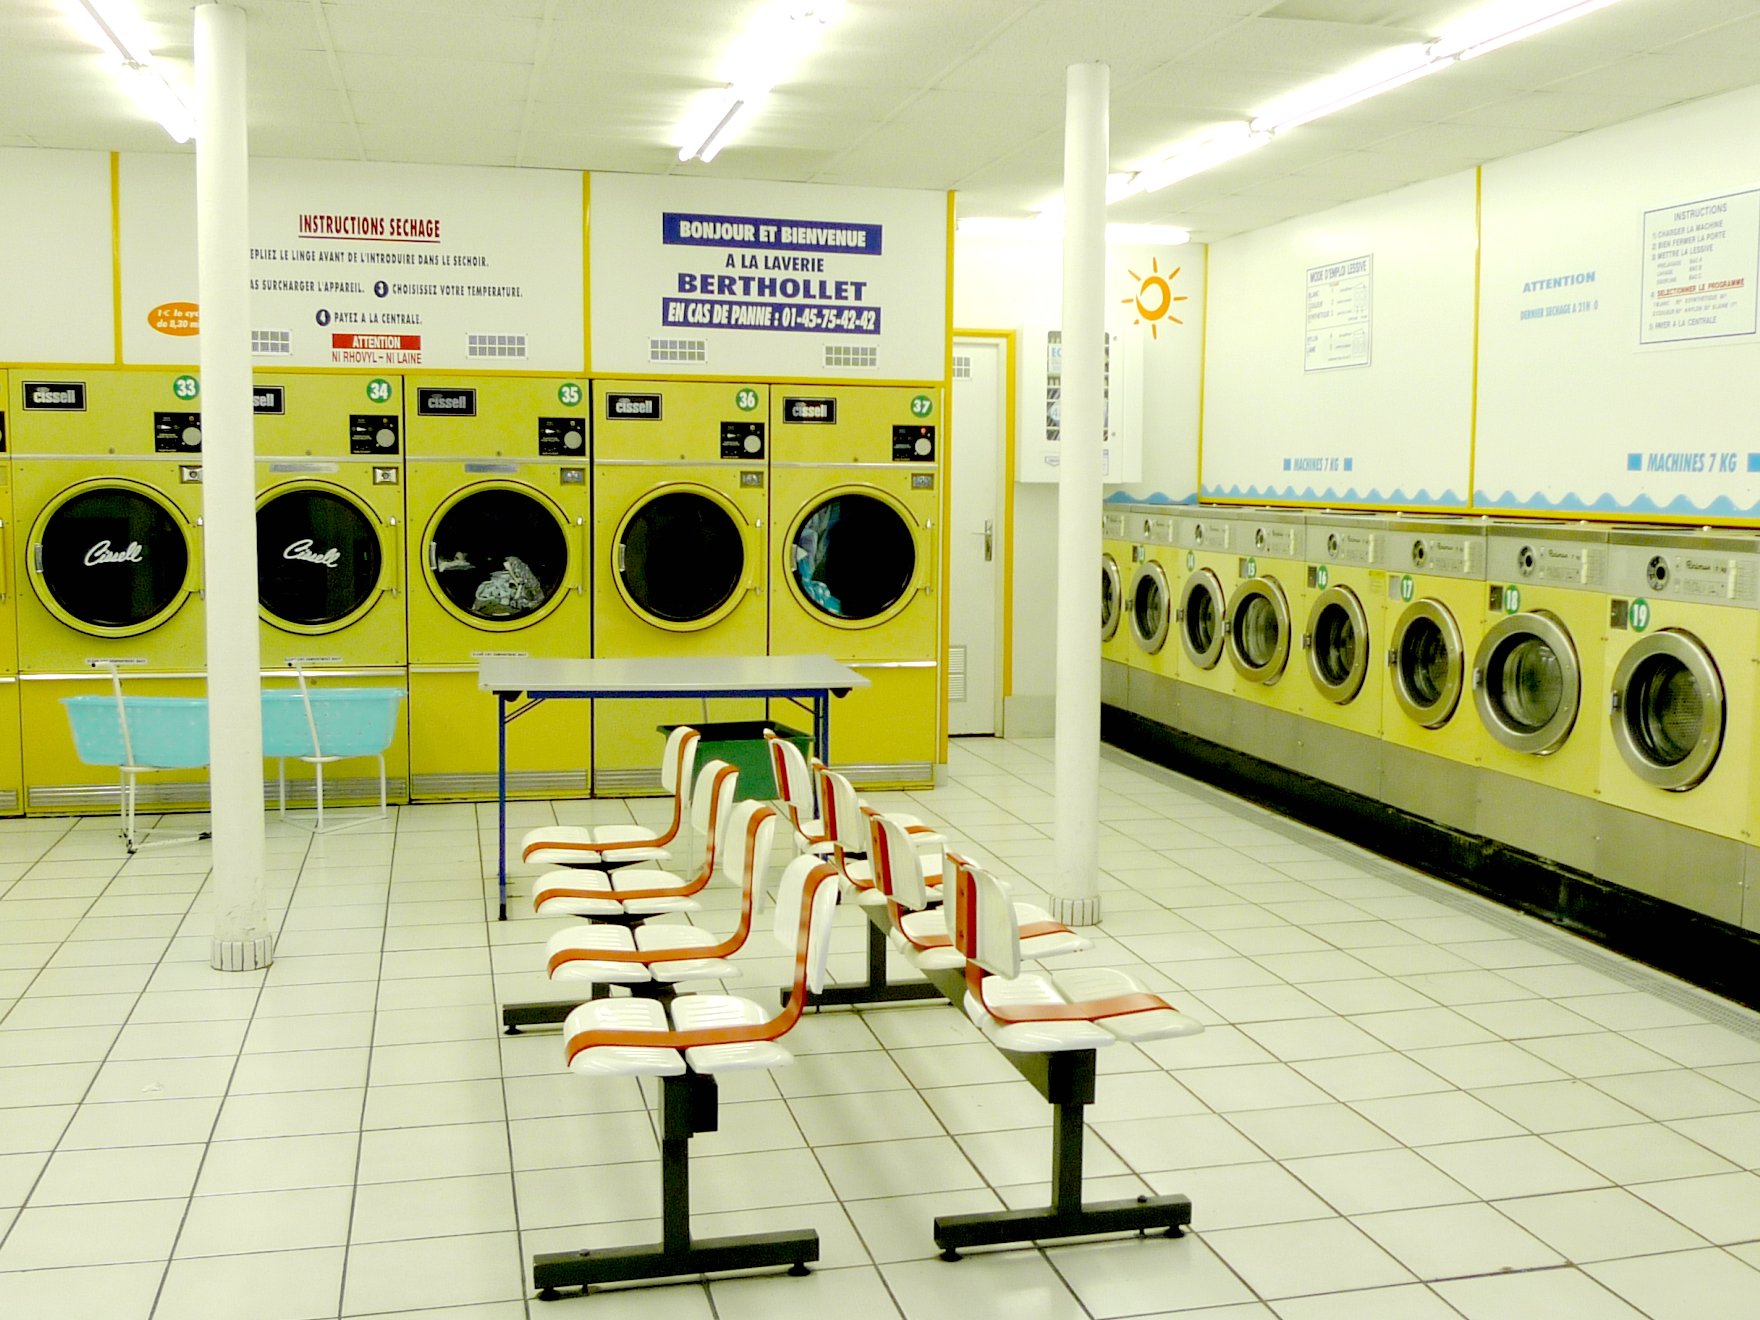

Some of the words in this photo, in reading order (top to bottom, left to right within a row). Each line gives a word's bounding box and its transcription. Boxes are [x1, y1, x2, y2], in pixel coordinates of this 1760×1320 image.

[1674, 203, 1728, 221] INSTRUCTIONS
[299, 214, 385, 236] INSTRUCTIONS
[389, 218, 440, 238] SECHAGE
[680, 221, 755, 241] BONJOUR
[759, 225, 777, 242] ET
[781, 227, 866, 247] BIENVENUE
[1658, 226, 1685, 238] CHARGER
[1686, 226, 1694, 234] LA
[1695, 219, 1723, 231] MACHINE
[1658, 241, 1671, 250] BIEN
[1672, 236, 1696, 247] FERMER
[1697, 234, 1705, 242] LA
[1706, 230, 1727, 240] PORTE
[280, 250, 288, 260] LE
[292, 250, 315, 261] LINGE
[319, 251, 344, 262] AVANT
[348, 252, 357, 263] DE
[361, 252, 415, 265] L'INTRODUIRE
[418, 254, 439, 265] DANS
[442, 255, 450, 266] LE
[453, 256, 489, 267] SECHOIR.
[1657, 249, 1680, 260] METTRE
[1689, 243, 1713, 255] LESSIVE
[725, 254, 735, 268] A
[741, 255, 758, 269] LA
[764, 256, 824, 272] LAVERIE
[1347, 260, 1367, 275] LESSIVE
[262, 280, 315, 292] SURCHARGER
[318, 281, 364, 293] L'APPAREIL.
[678, 273, 867, 301] BERTHOLLET
[1523, 271, 1596, 293] ATTENTION
[393, 284, 437, 295] CHOISISSEZ
[440, 285, 464, 296] VOTRE
[467, 286, 523, 297] TEMPERATURE.
[157, 319, 167, 328] de
[334, 312, 358, 323] PAYEZ
[361, 313, 366, 323] A
[369, 313, 379, 323] LA
[382, 313, 422, 325] CENTRALE.
[668, 302, 685, 322] EN
[687, 304, 710, 323] CAS
[713, 305, 729, 324] DE
[731, 306, 772, 326] PANNE
[782, 307, 875, 330] 01-45-75-42-42
[1678, 319, 1686, 327] LA
[1688, 315, 1717, 326] CENTRALE
[352, 336, 401, 348] ATTENTION
[332, 351, 340, 362] NI
[344, 352, 377, 363] RHOVYL
[386, 352, 395, 363] NI
[397, 353, 422, 364] LAINE
[33, 388, 76, 403] cissell
[176, 379, 196, 396] 33
[370, 383, 388, 400] 34
[561, 387, 579, 403] 35
[427, 395, 467, 409] cissell
[615, 399, 653, 413] cissell
[739, 391, 756, 407] 36
[912, 399, 931, 413] 37
[791, 403, 828, 418] cissell
[1294, 457, 1323, 471] MACHINES
[1647, 453, 1705, 472] MACHINES
[1708, 453, 1717, 472] 7
[1719, 453, 1737, 472] KG
[1248, 562, 1255, 576] 15
[1318, 571, 1327, 586] 16
[1403, 580, 1413, 598] 17
[1506, 590, 1519, 611] 18
[1633, 604, 1648, 627] 19
